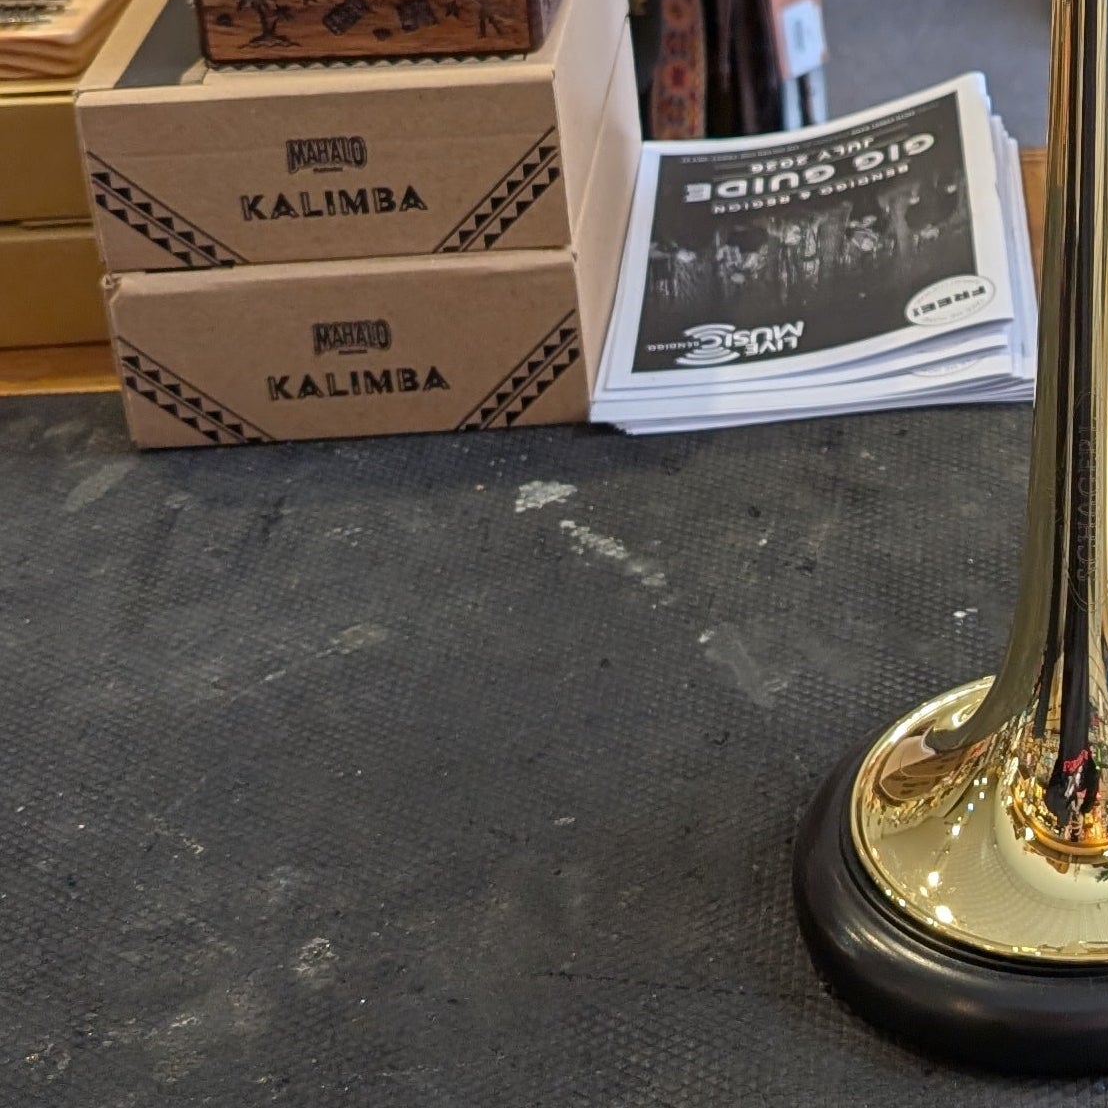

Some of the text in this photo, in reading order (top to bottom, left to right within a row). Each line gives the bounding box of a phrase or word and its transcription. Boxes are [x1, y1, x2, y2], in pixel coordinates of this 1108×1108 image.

[286, 135, 368, 174] MAHALO
[817, 135, 875, 162] JULY
[684, 132, 935, 204] GIG GUIDE
[819, 162, 910, 196] BENDIGO
[240, 185, 429, 222] KALIMBA
[712, 194, 791, 214] REGION
[912, 285, 987, 318] FREE!
[311, 318, 392, 357] MAHALO
[697, 320, 805, 351] MUSIC
[745, 335, 799, 358] LIVE
[267, 365, 451, 402] KALIMBA
